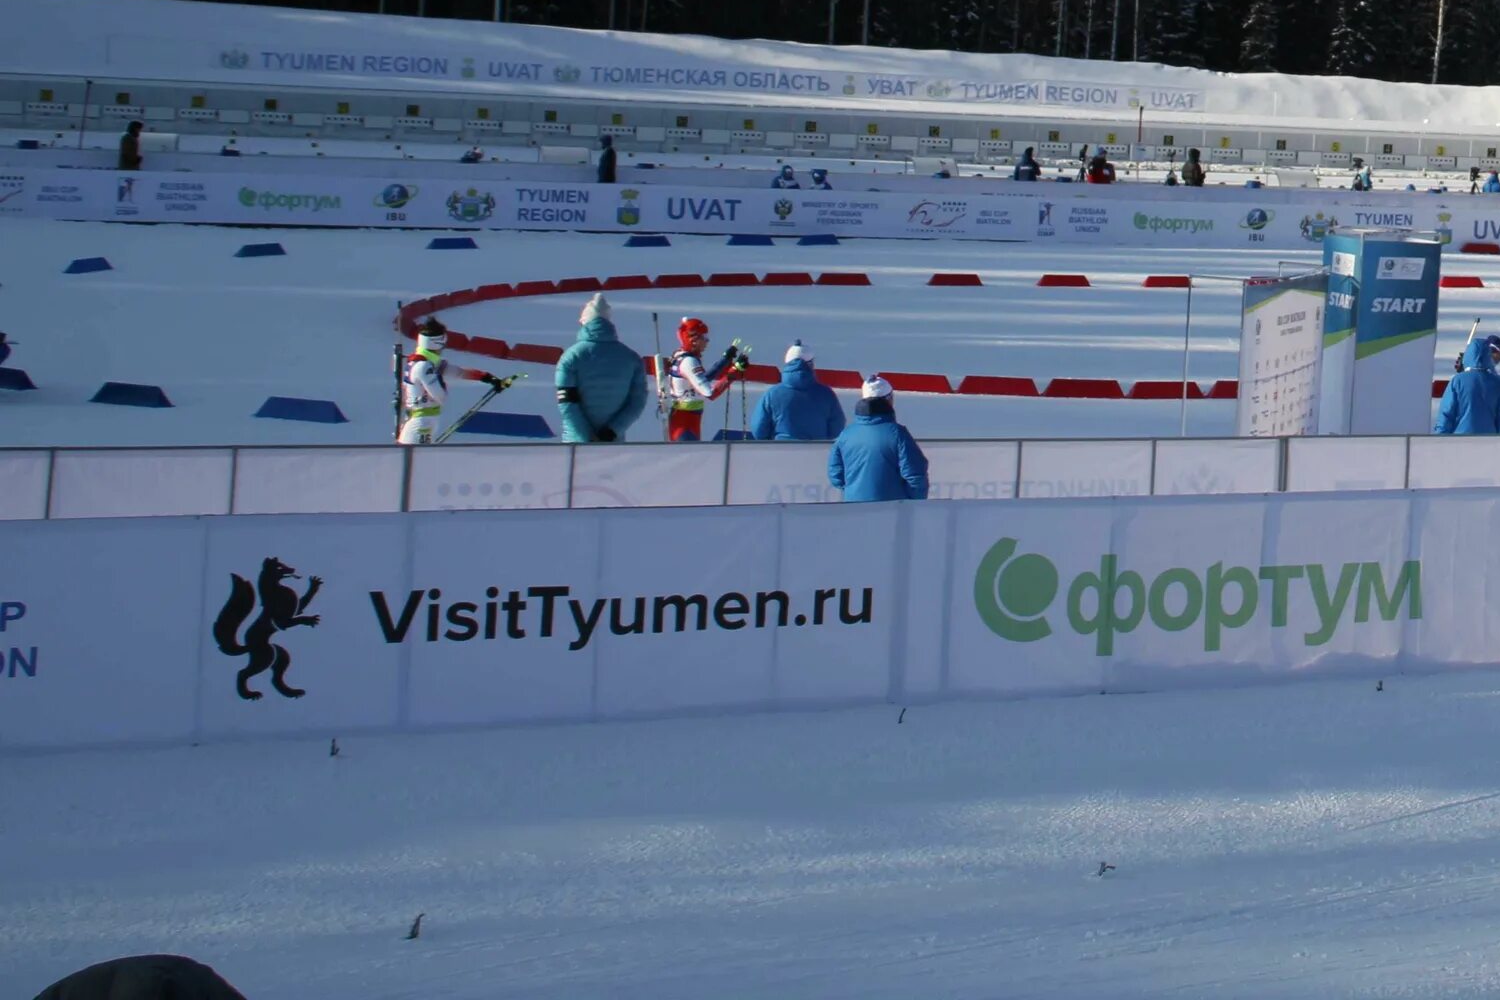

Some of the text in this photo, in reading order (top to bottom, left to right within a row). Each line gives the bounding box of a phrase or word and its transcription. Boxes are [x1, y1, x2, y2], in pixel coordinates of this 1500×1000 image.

[261, 52, 448, 75] TYUMEN REGION
[488, 62, 543, 80] UVAT
[590, 66, 830, 92] ТЮМЕНСКАЯ ОБЛАСТЬ
[868, 79, 917, 96] УВАТ
[961, 83, 1117, 104] TYUMEN REGION
[1151, 91, 1196, 109] UVAT
[257, 190, 342, 211] фортум
[516, 188, 589, 203] TYUMEN
[386, 212, 406, 221] IBU
[517, 207, 586, 222] REGION
[667, 198, 742, 221] UVAT
[1071, 207, 1106, 215] RUSSIAN
[1068, 216, 1108, 224] BIATHLON
[1149, 215, 1213, 234] фортум
[1356, 213, 1413, 226] TYUMEN
[1075, 225, 1100, 233] UNION
[1248, 233, 1264, 242] IBU
[1329, 291, 1355, 309] START
[1371, 297, 1426, 313] START
[1067, 554, 1423, 656] фортум
[369, 585, 873, 651] VisitTyumen.ru
[0, 646, 38, 678] N
